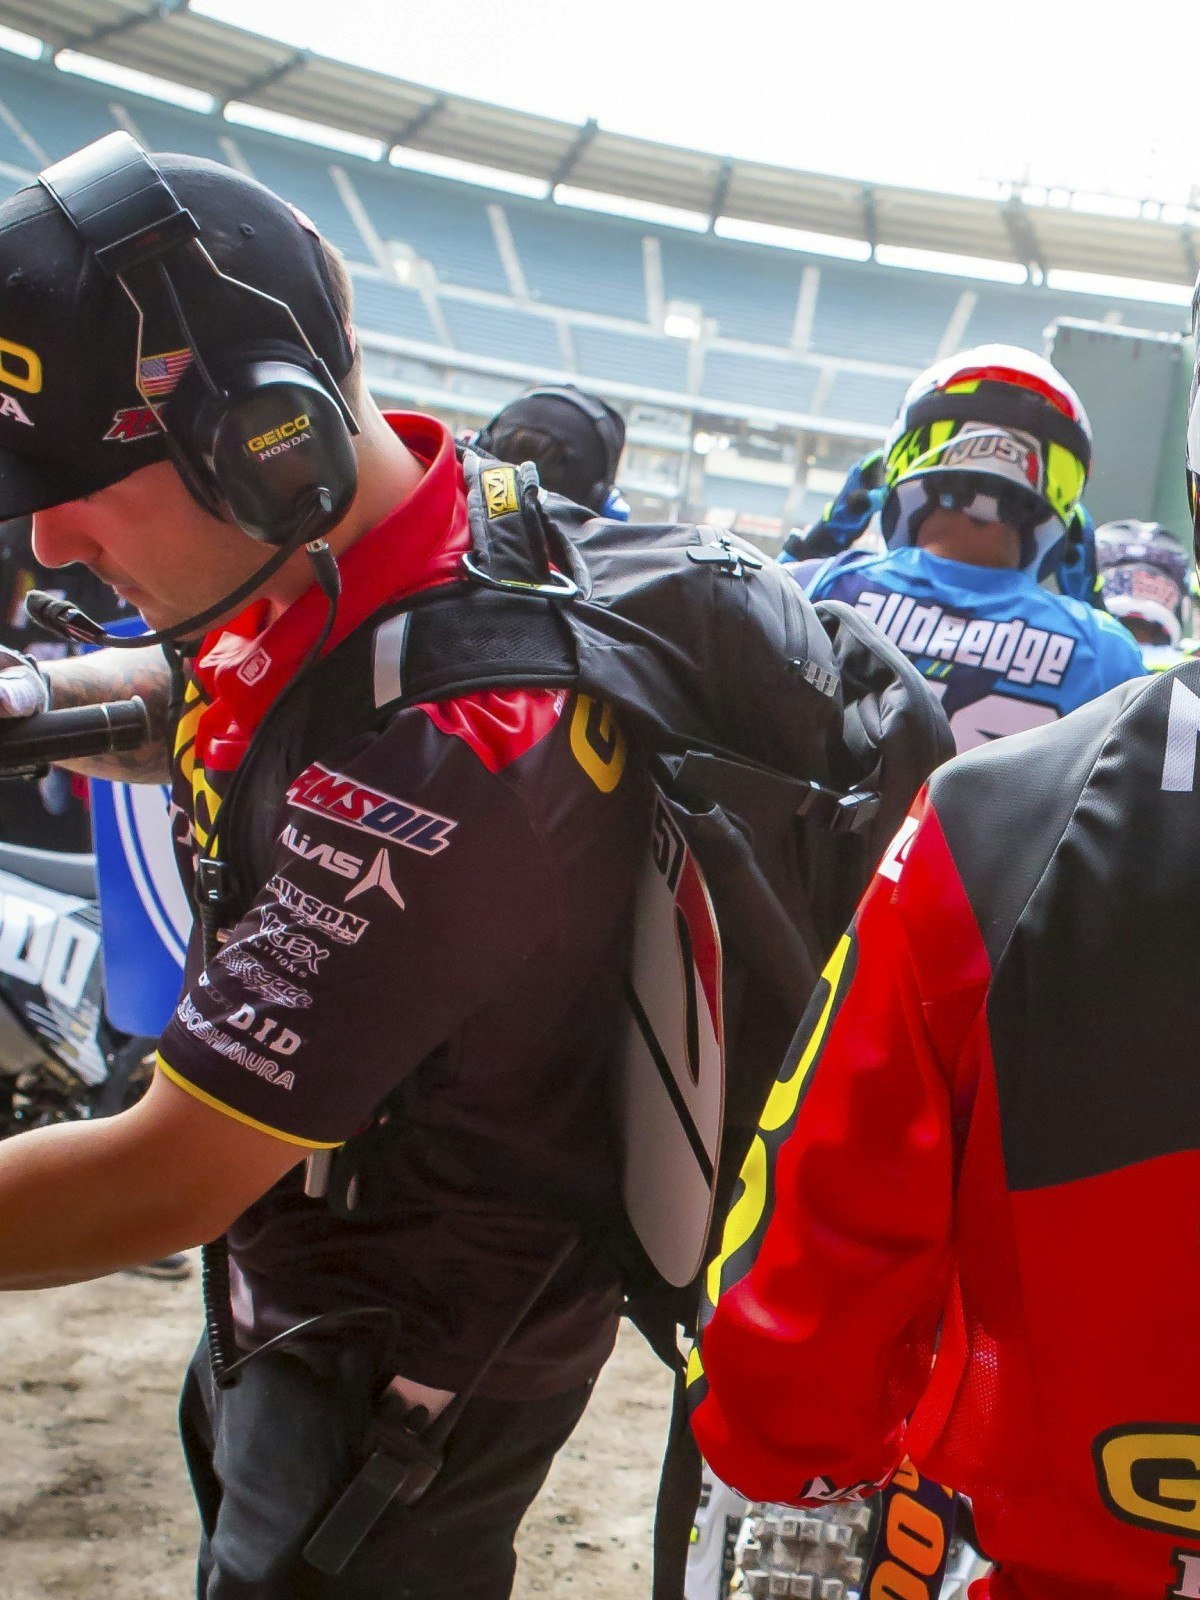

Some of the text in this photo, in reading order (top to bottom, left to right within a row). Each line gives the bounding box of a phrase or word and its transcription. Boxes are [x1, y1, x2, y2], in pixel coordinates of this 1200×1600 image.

[247, 414, 310, 453] GEICO
[259, 432, 311, 461] HONDA
[180, 998, 297, 1092] YOSHIMURA
